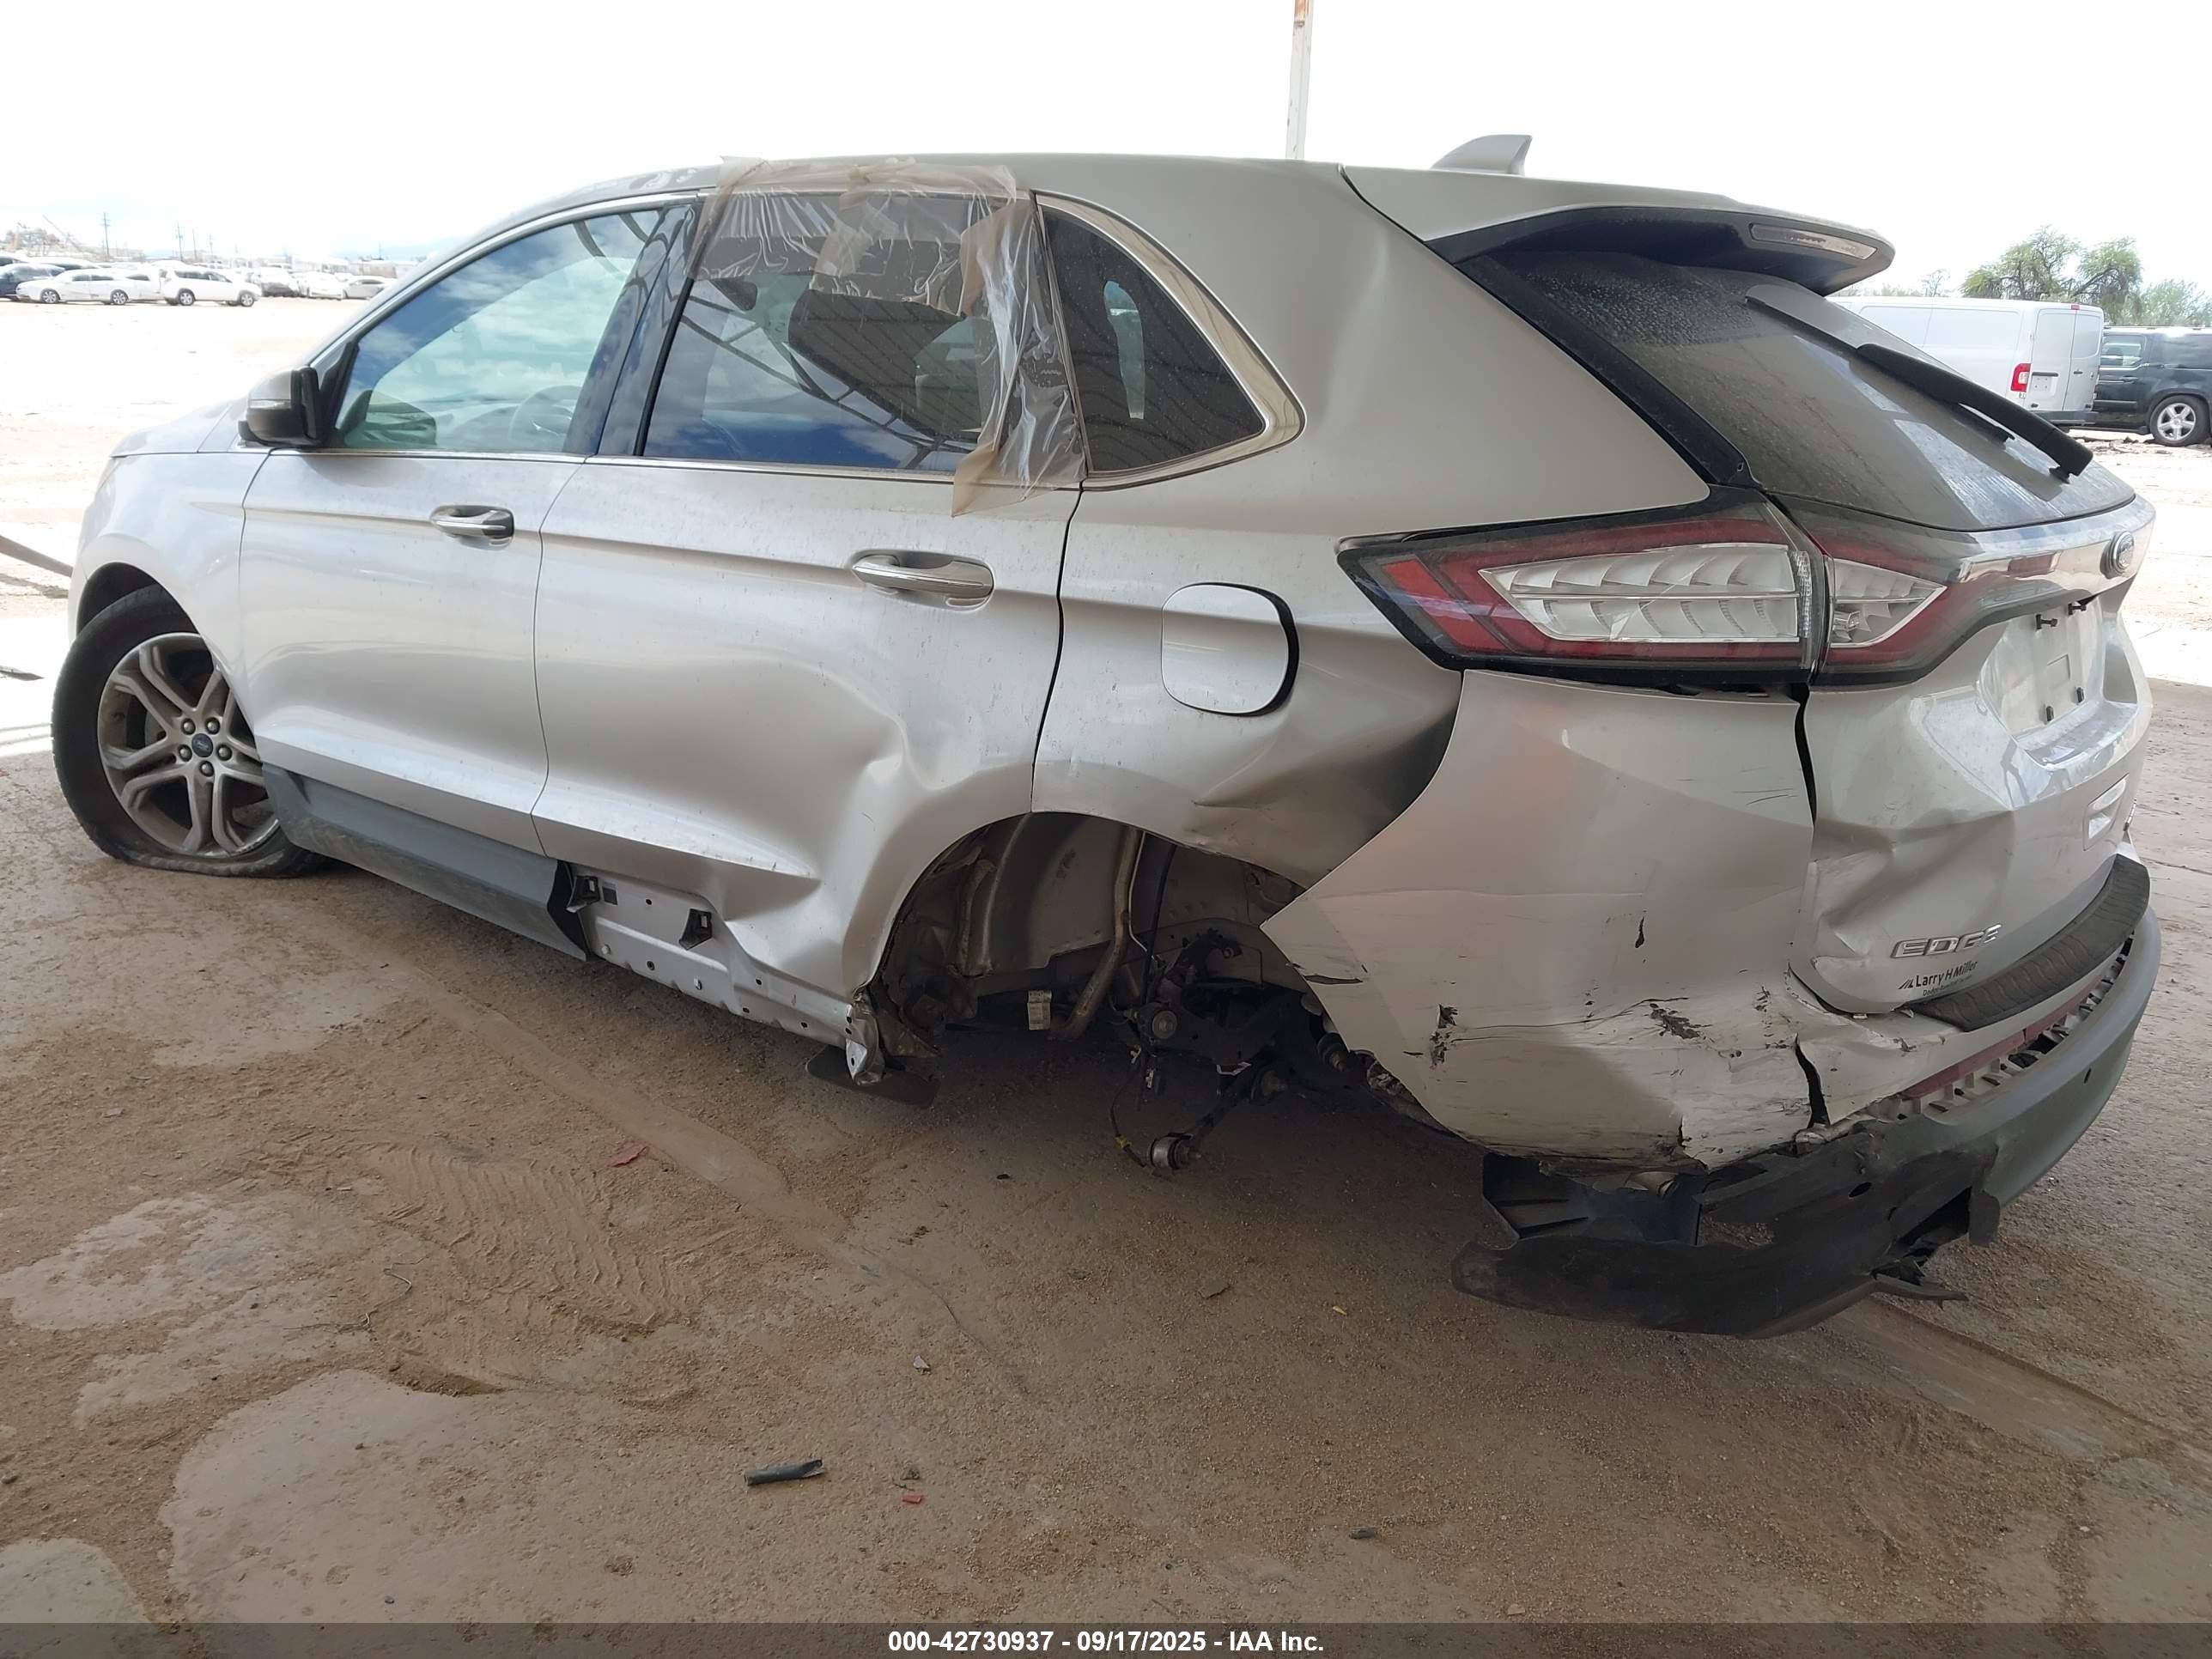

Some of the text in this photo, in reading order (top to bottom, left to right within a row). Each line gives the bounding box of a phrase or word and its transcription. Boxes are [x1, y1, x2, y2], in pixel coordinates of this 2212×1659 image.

[1890, 923, 2002, 958] EDGE
[1916, 973, 1945, 988] Larry
[1945, 969, 1954, 981] H
[1953, 961, 1978, 977] Miller
